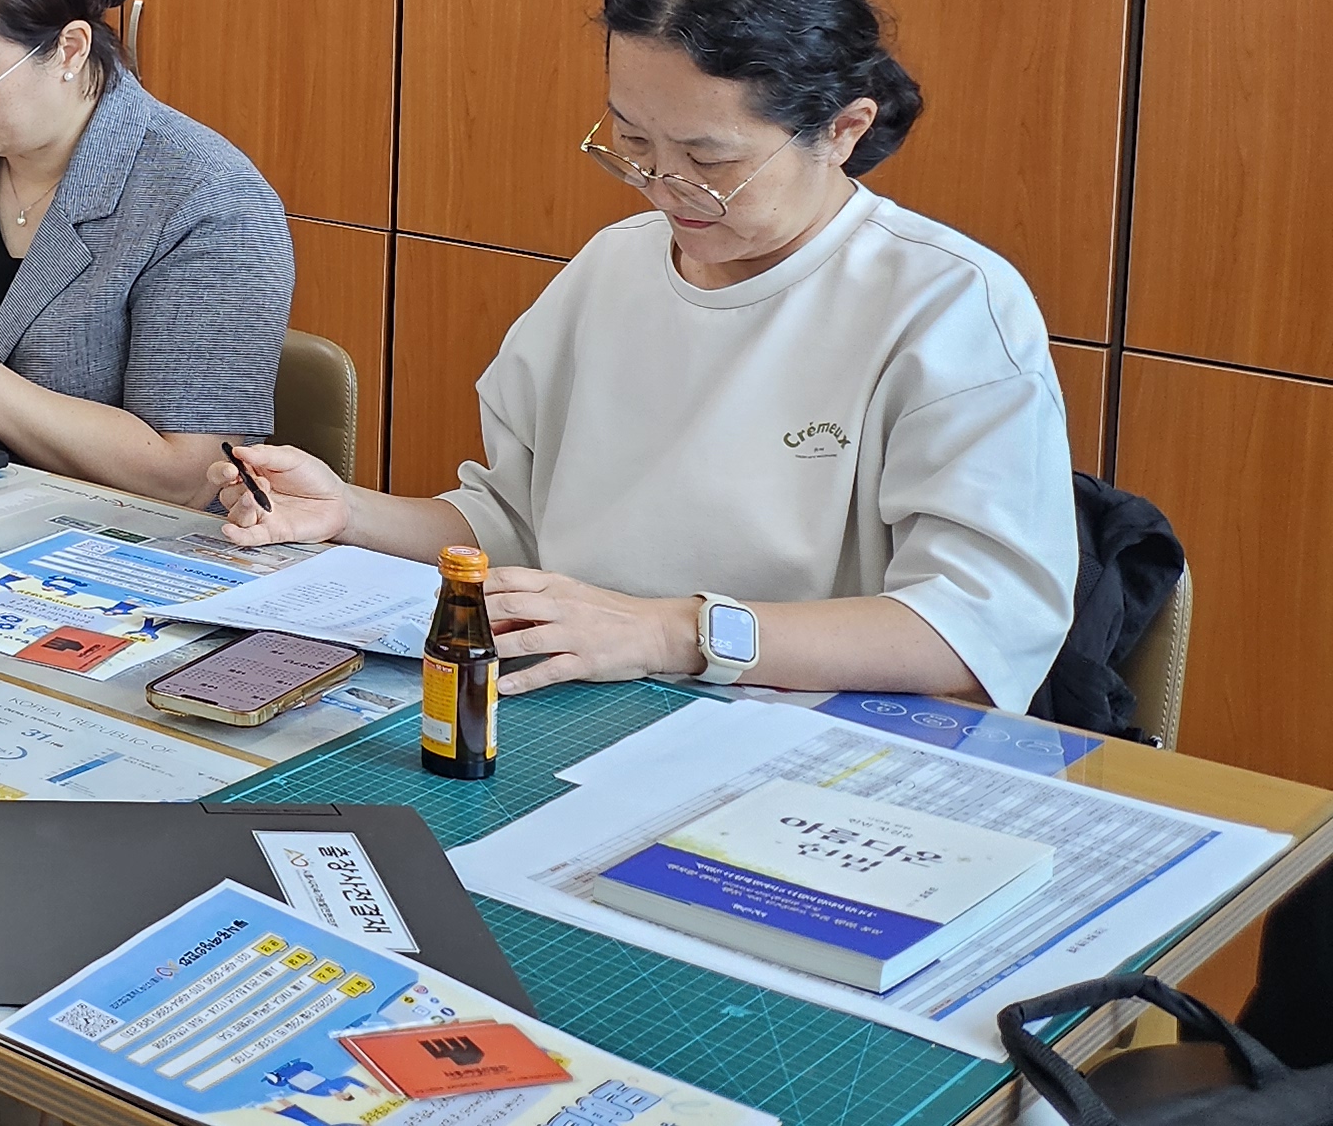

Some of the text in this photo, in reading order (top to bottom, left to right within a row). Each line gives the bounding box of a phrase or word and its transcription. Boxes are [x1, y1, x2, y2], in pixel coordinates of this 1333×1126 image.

[783, 421, 852, 450] Crémeux
[68, 716, 149, 747] REPUBLIC
[318, 845, 393, 934] 출장사전결재
